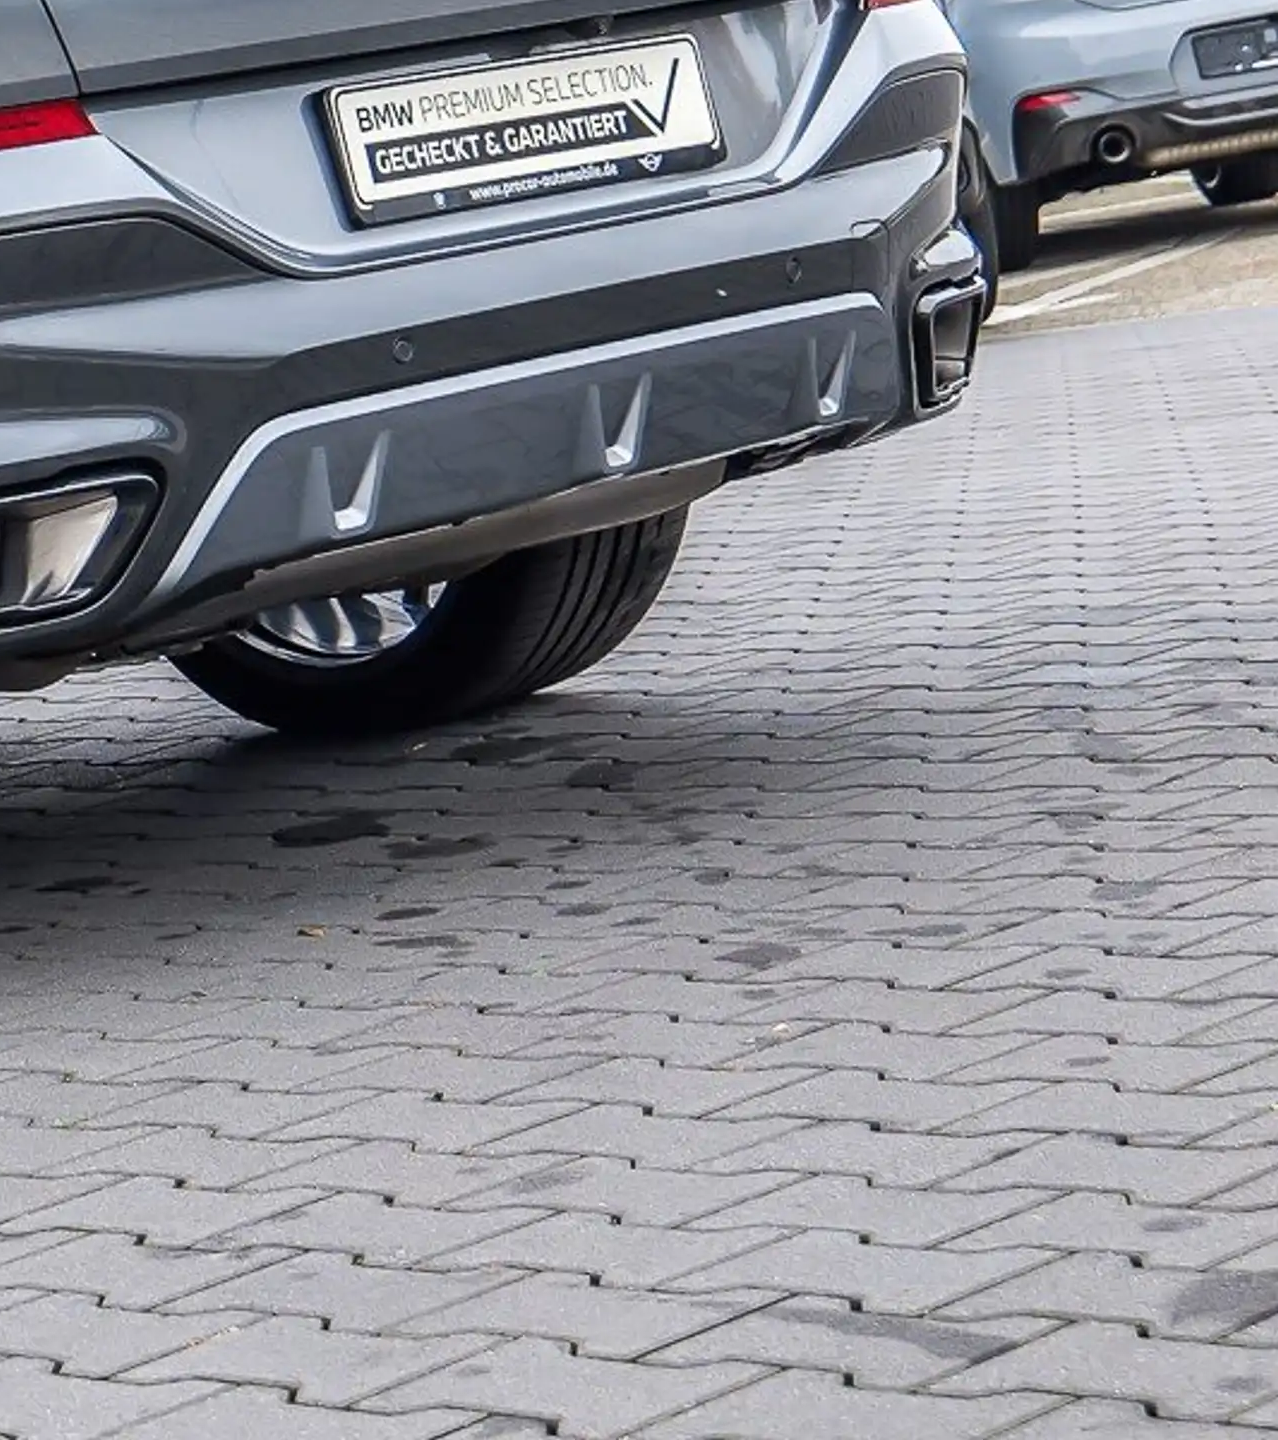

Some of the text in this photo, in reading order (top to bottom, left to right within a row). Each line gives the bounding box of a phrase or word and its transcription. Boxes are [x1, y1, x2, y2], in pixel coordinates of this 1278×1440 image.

[356, 63, 654, 133] BMW PREMIUM SELECTION.
[374, 109, 628, 175] GECHECKT & GARANTIERT
